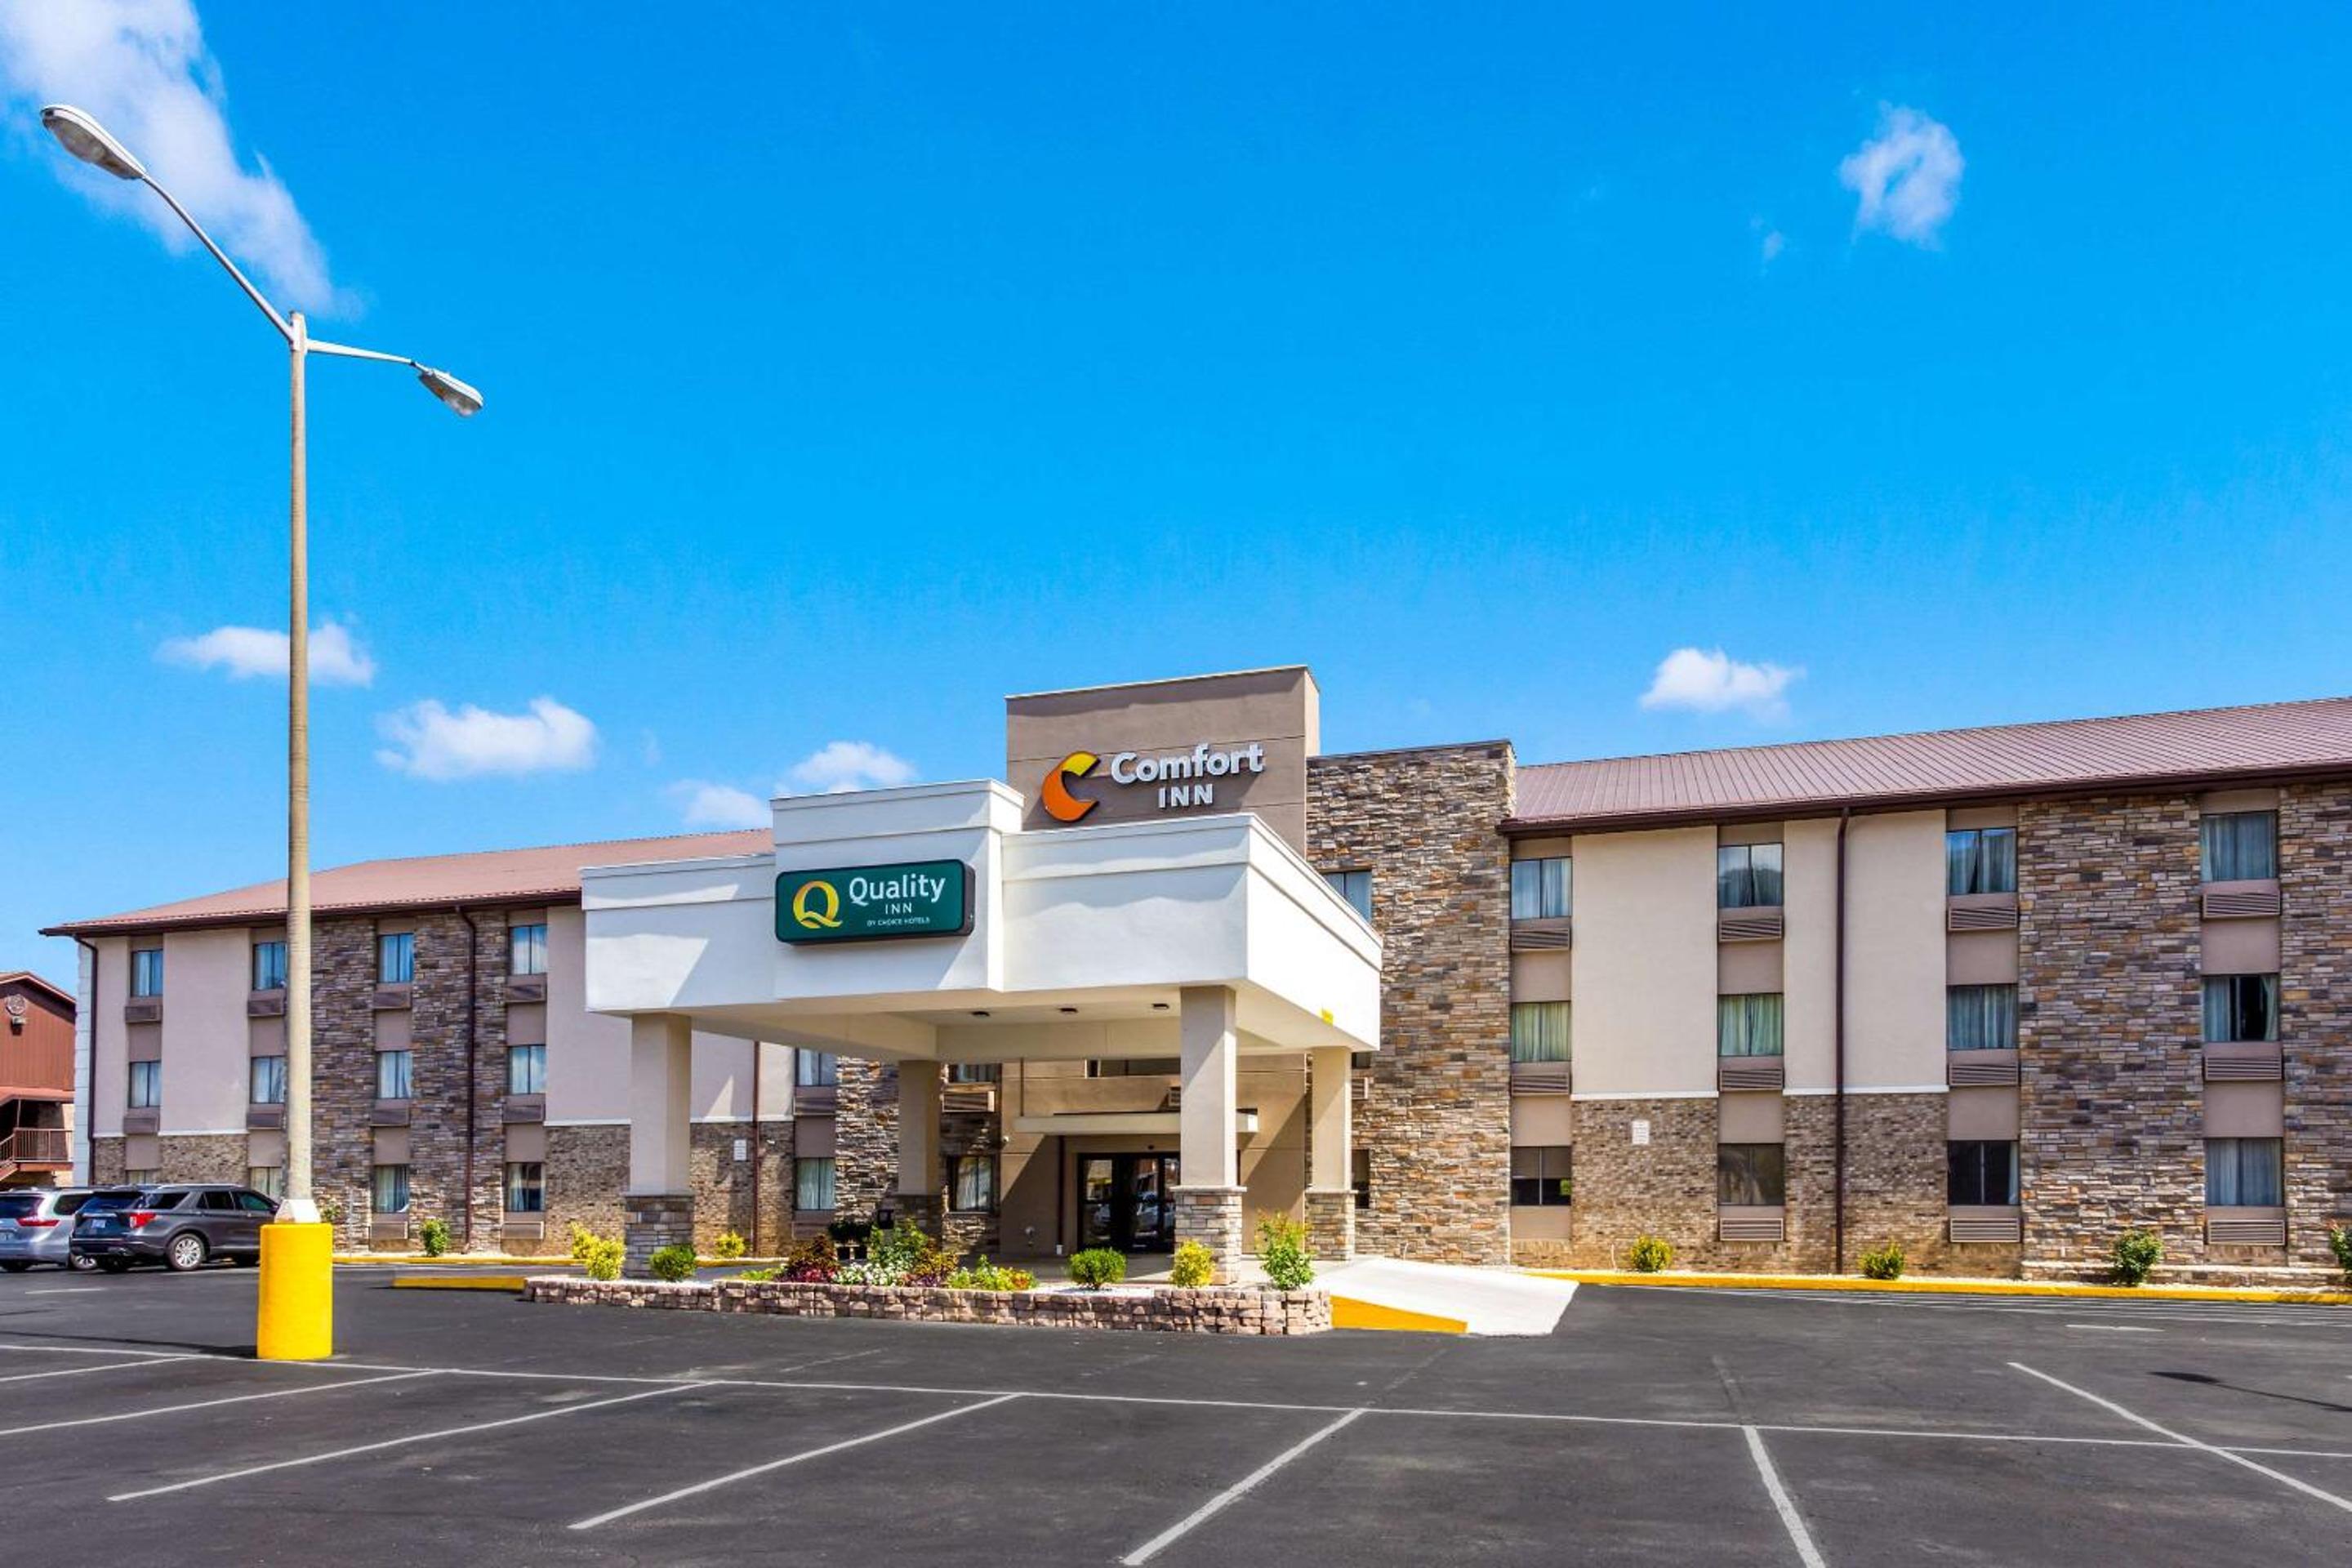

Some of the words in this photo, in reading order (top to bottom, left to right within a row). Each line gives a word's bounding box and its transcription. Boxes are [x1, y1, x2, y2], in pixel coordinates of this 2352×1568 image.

[1111, 742, 1264, 785] Comfort
[1158, 783, 1214, 808] INN
[793, 880, 843, 929] Q
[849, 873, 946, 906] Quality
[885, 902, 912, 915] INN
